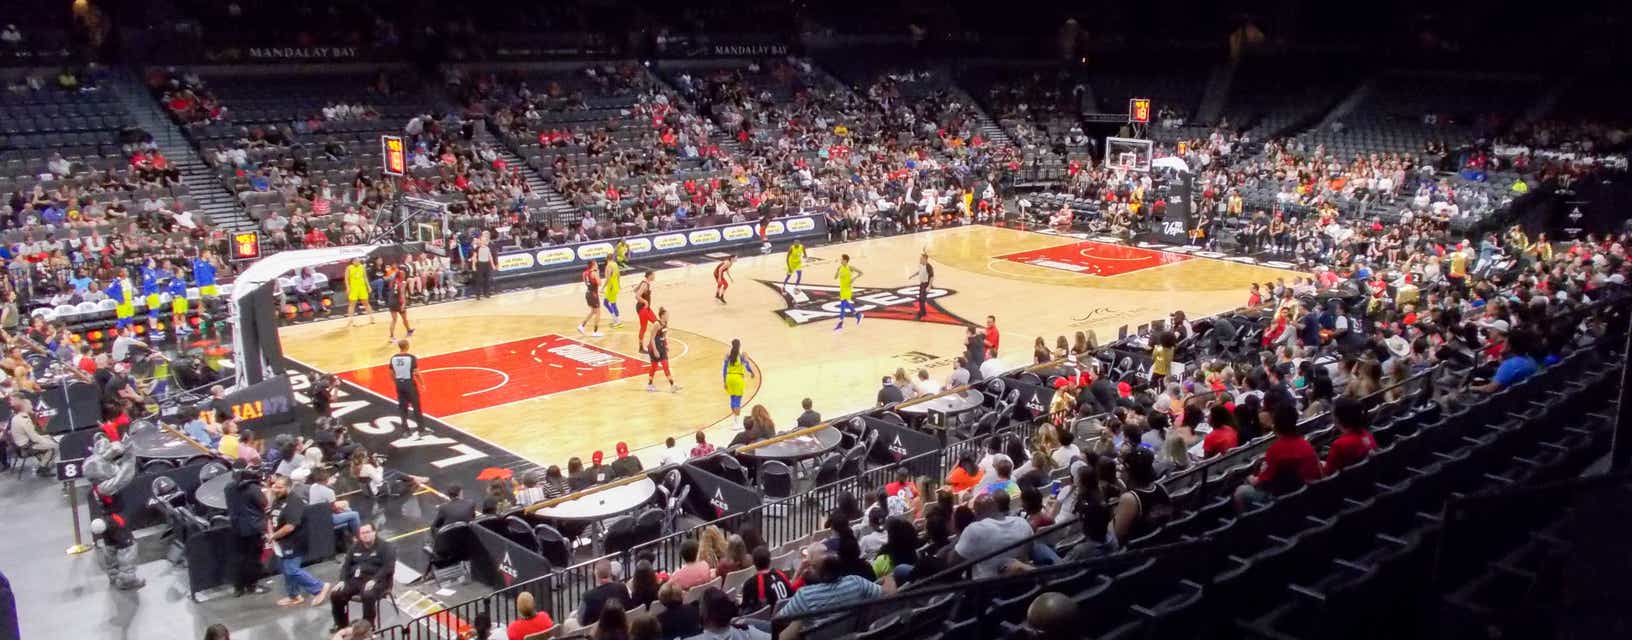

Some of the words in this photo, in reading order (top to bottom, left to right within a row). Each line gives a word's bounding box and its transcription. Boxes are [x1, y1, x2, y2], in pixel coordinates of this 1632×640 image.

[249, 47, 328, 57] MANDALAY
[332, 48, 357, 57] BAY
[715, 45, 768, 55] MANDALAY
[771, 45, 788, 54] BAY
[933, 412, 939, 425] 1
[65, 463, 77, 478] 8
[771, 580, 788, 600] 10
